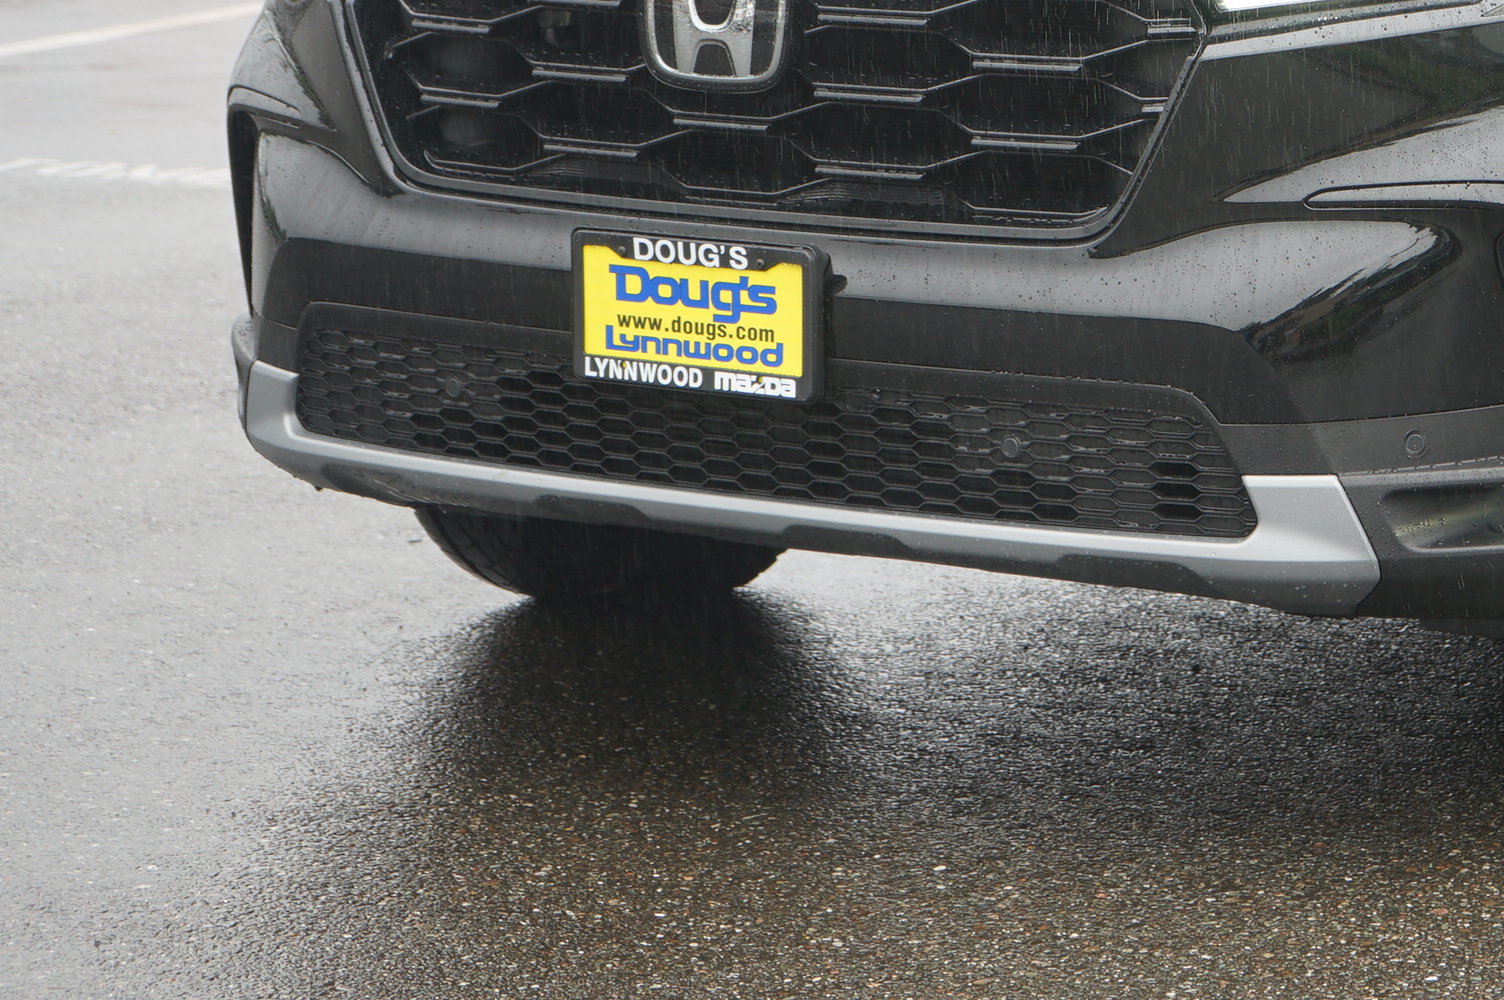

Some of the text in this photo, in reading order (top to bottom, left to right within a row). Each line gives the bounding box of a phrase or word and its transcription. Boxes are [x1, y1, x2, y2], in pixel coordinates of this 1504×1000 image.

[632, 237, 749, 270] DOUG'S
[617, 314, 776, 343] www.dougs.com
[605, 325, 784, 367] Lynnwood
[584, 356, 703, 388] LYNNWOOD
